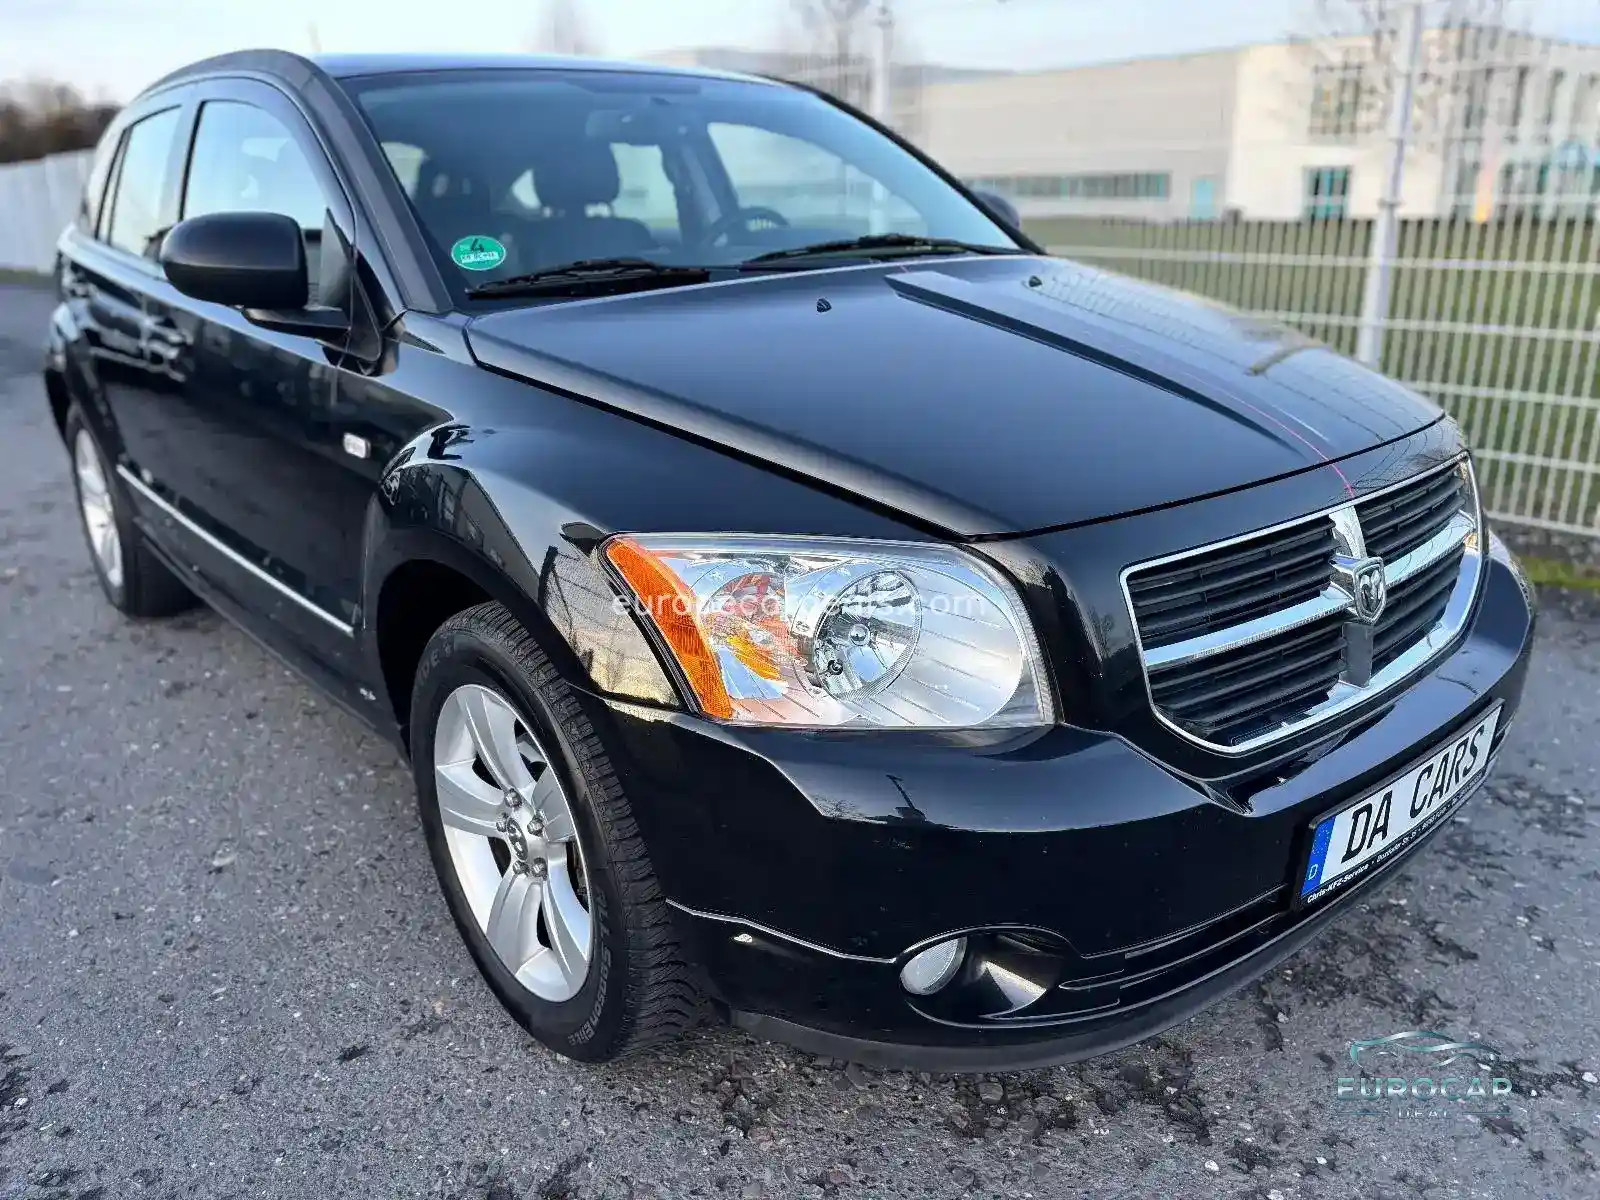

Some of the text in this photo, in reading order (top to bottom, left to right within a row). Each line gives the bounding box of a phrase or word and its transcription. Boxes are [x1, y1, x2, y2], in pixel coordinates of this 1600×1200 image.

[1341, 790, 1393, 864] DA
[1410, 725, 1485, 819] CARS
[1308, 864, 1318, 880] D
